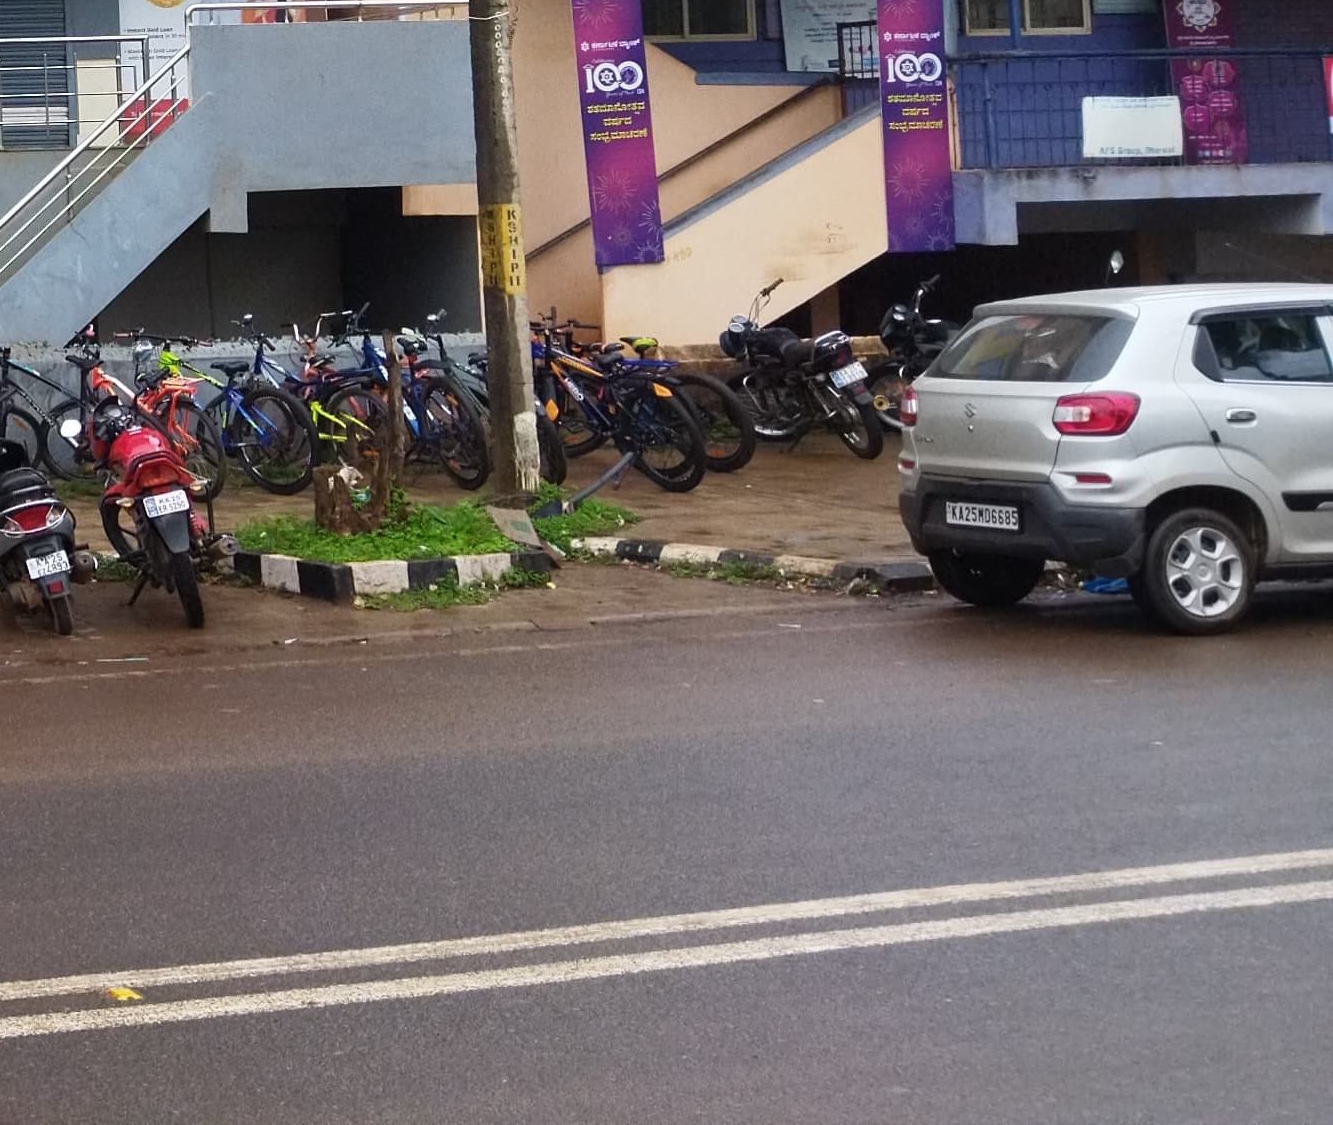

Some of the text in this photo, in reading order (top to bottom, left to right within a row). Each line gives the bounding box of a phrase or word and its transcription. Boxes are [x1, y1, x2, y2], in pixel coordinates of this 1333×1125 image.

[583, 61, 643, 93] 100
[885, 53, 942, 82] 100
[952, 505, 1018, 525] KA25MD6685
